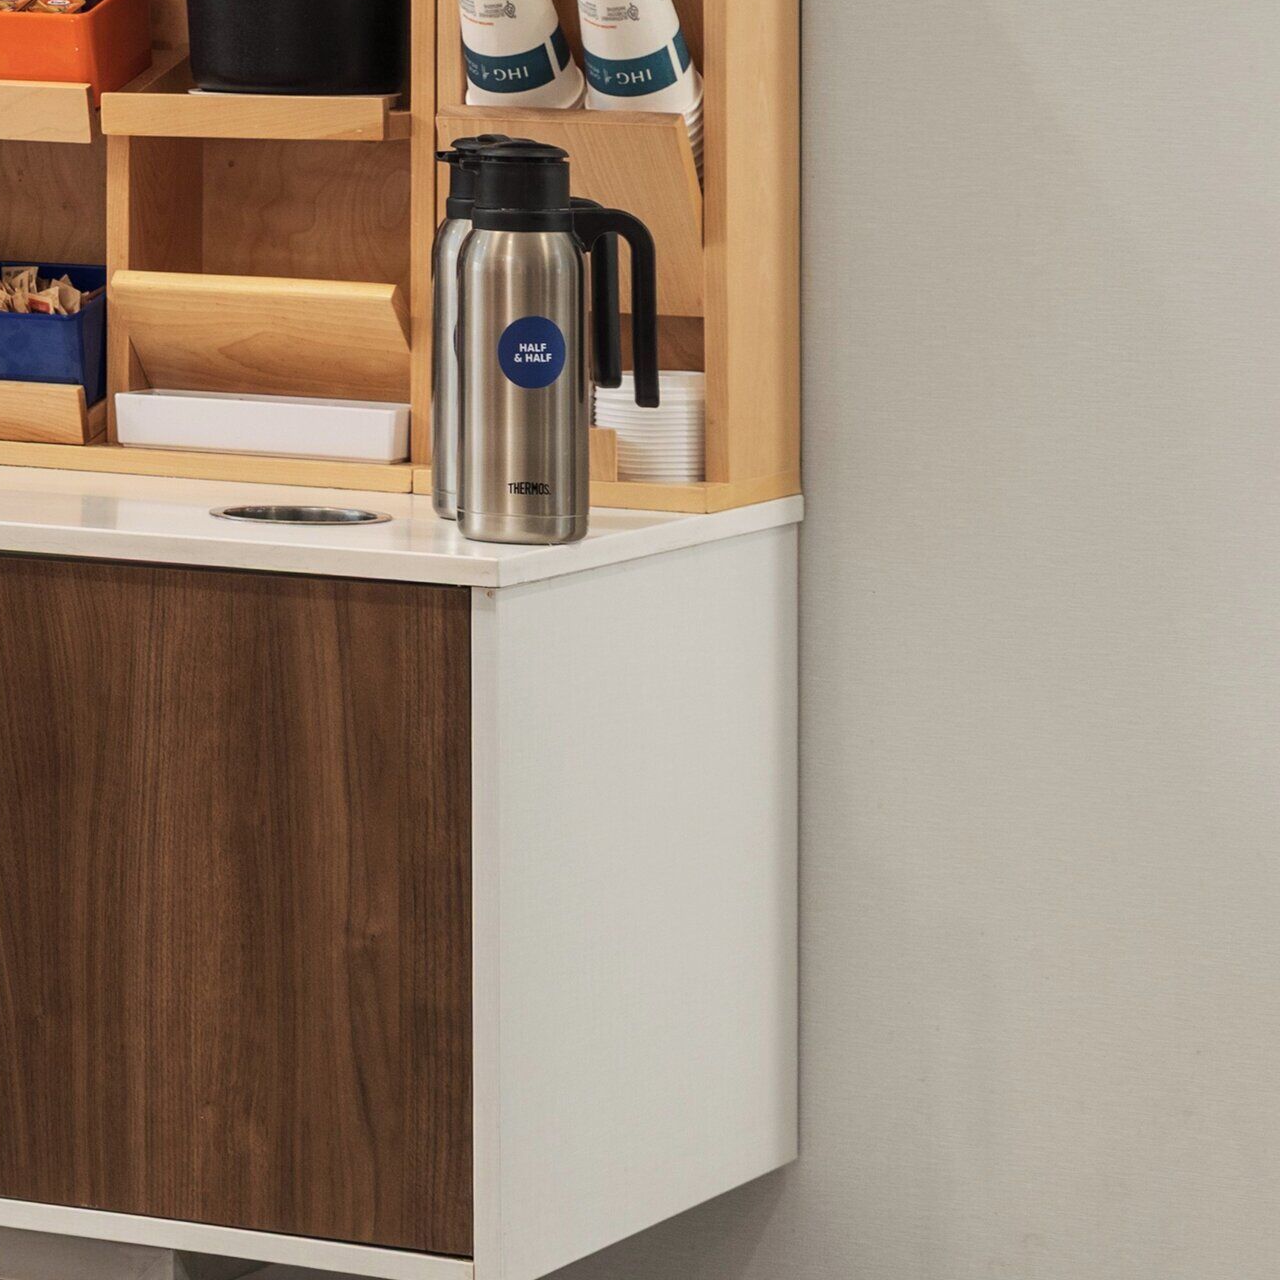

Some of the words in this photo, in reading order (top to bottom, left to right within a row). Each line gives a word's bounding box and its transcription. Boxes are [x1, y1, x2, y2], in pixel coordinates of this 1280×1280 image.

[493, 65, 529, 82] IHG
[616, 68, 652, 85] IHG
[519, 343, 547, 352] HALF
[513, 353, 523, 363] &
[525, 353, 552, 363] HALF
